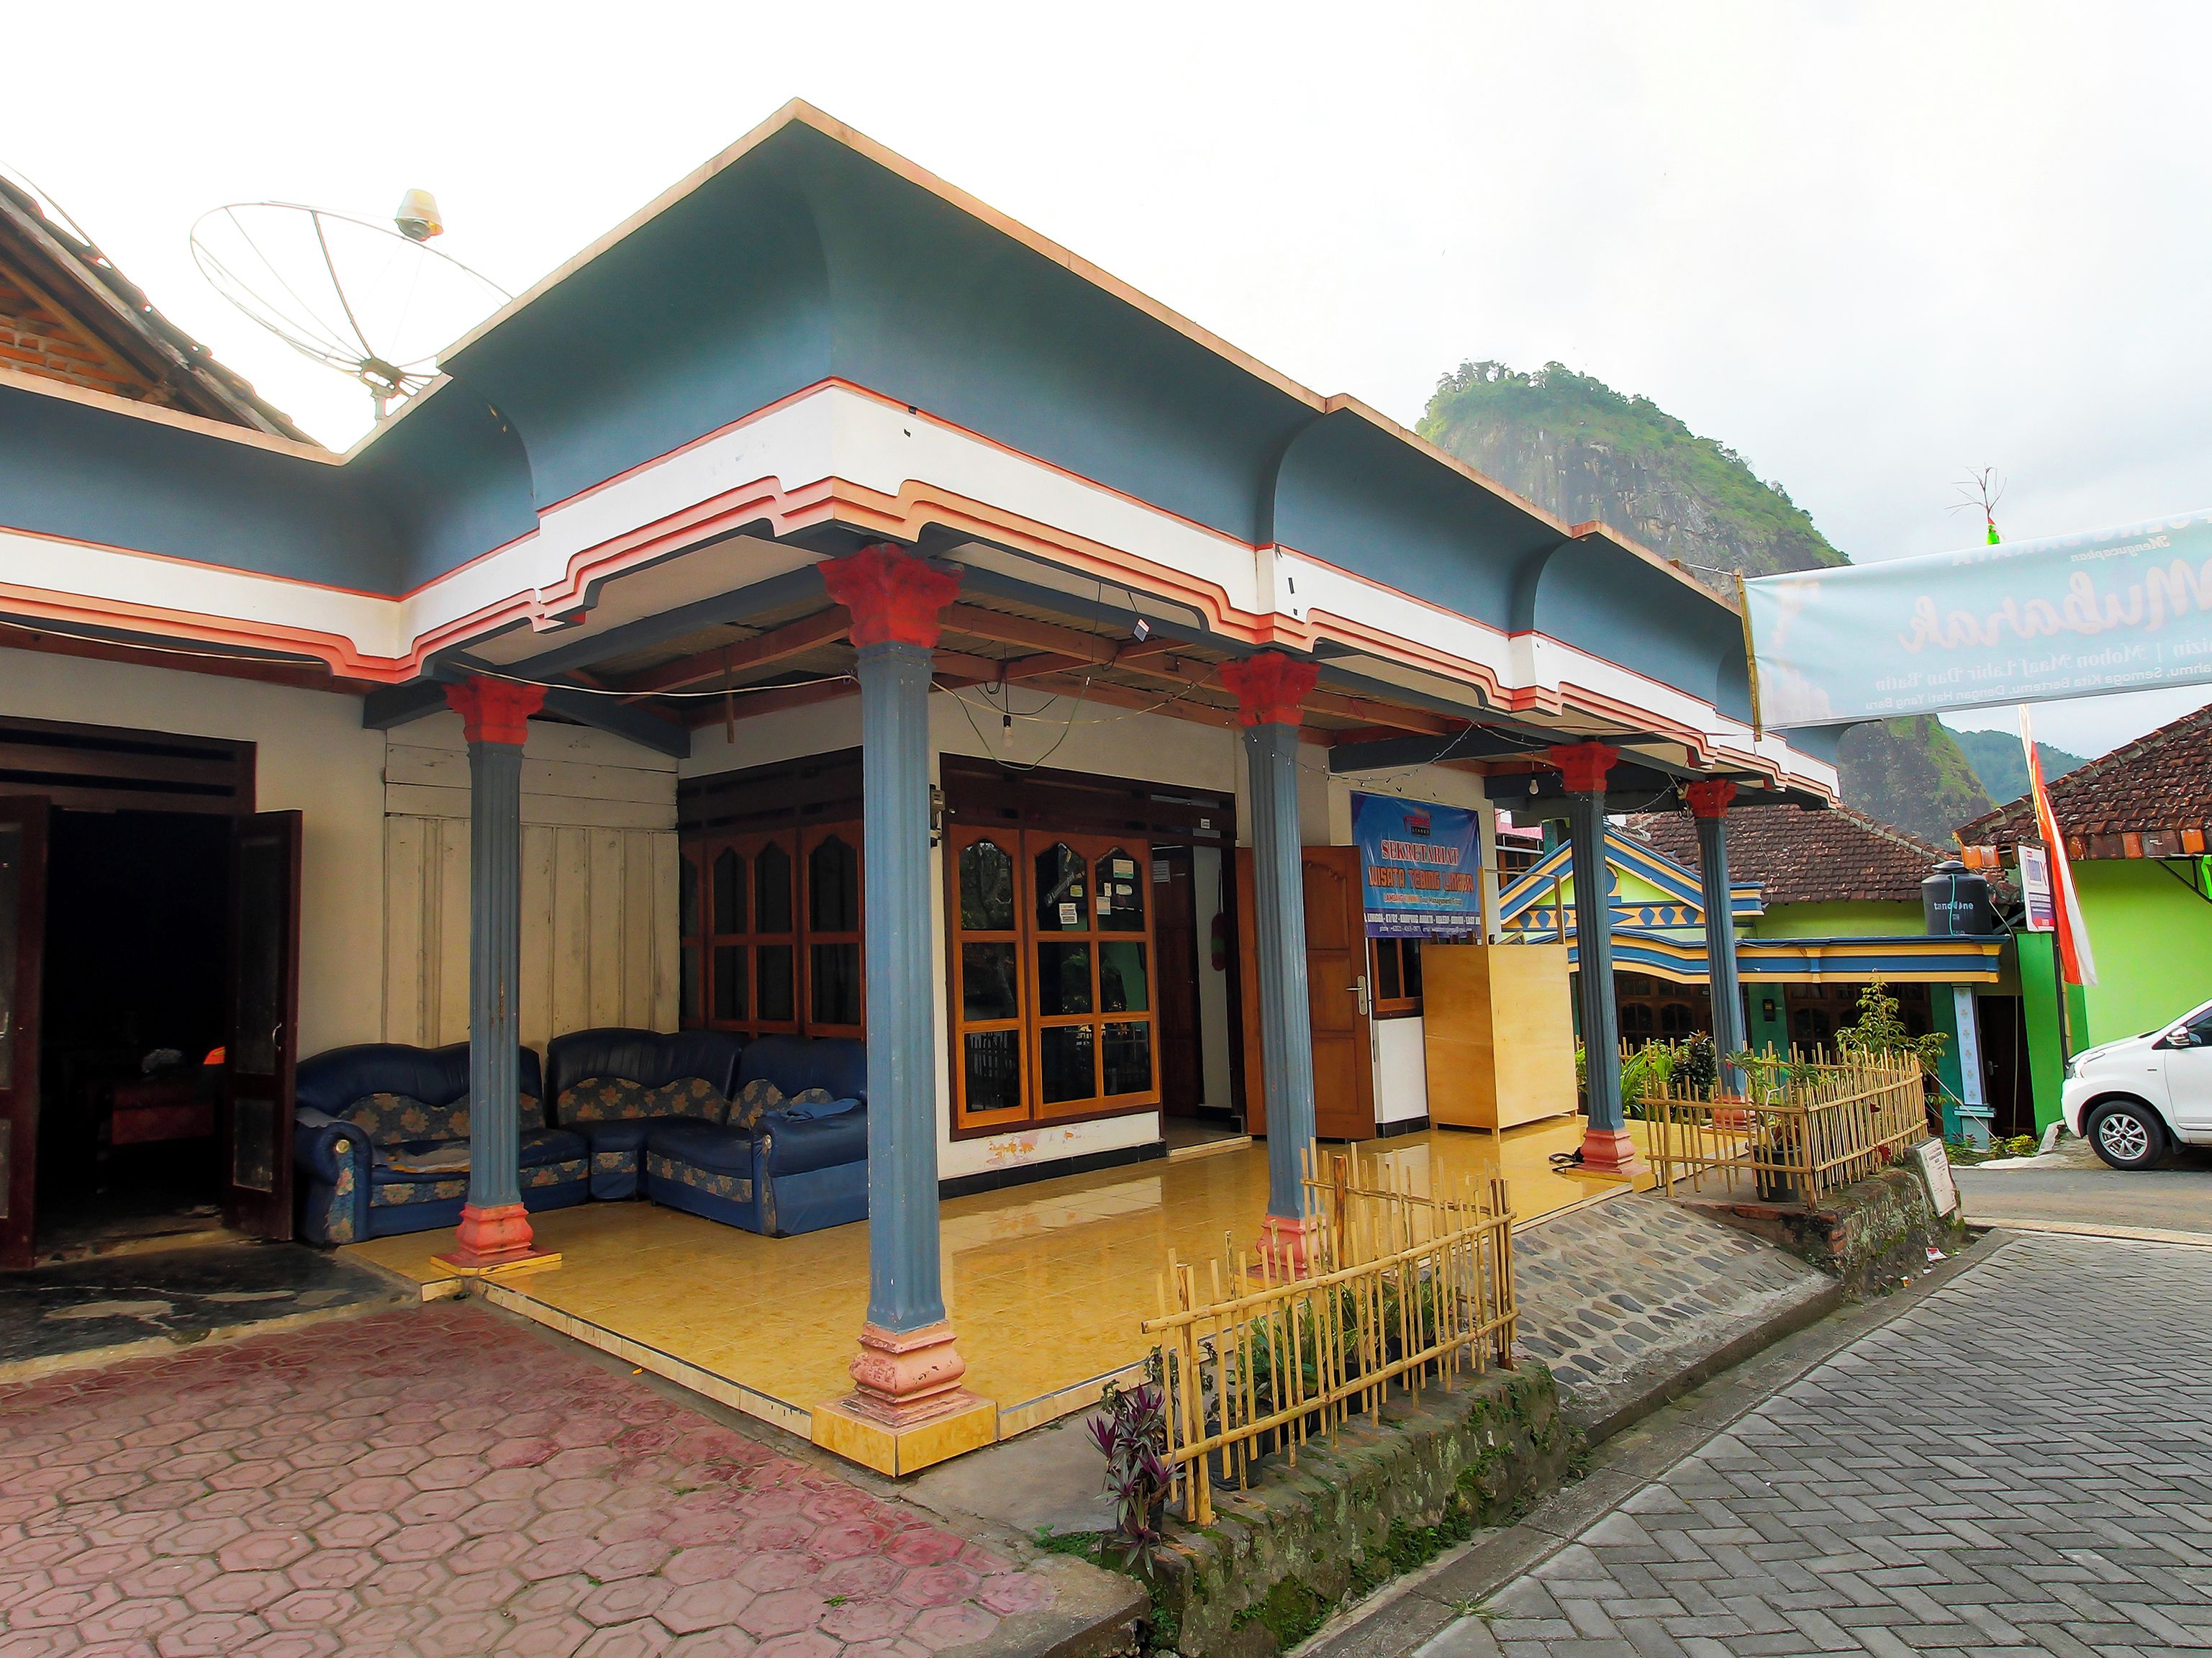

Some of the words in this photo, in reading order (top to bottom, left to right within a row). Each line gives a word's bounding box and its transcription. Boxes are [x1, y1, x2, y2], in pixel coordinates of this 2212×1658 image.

[1382, 840, 1458, 865] SEKRETARIAT
[1368, 866, 1405, 887] WISATA
[1408, 869, 1440, 891] TEBING
